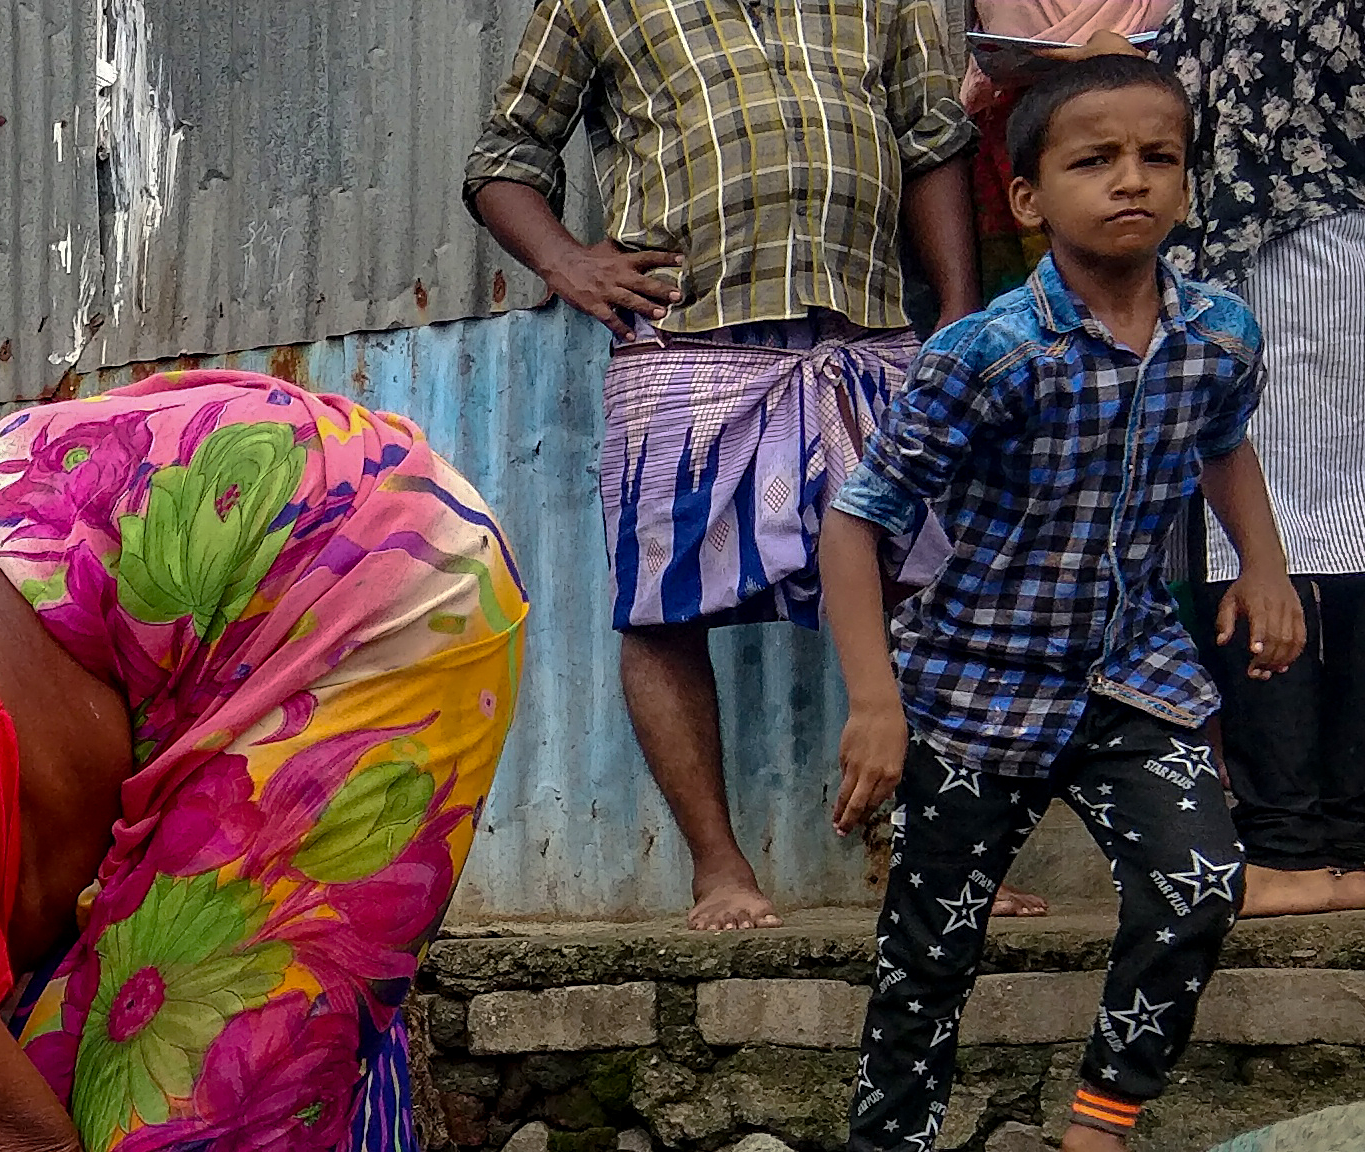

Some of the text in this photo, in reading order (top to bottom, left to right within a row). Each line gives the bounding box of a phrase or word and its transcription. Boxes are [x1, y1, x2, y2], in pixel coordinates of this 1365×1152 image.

[1143, 759, 1196, 790] STAR PLUS
[1149, 869, 1191, 917] STAR PLUS
